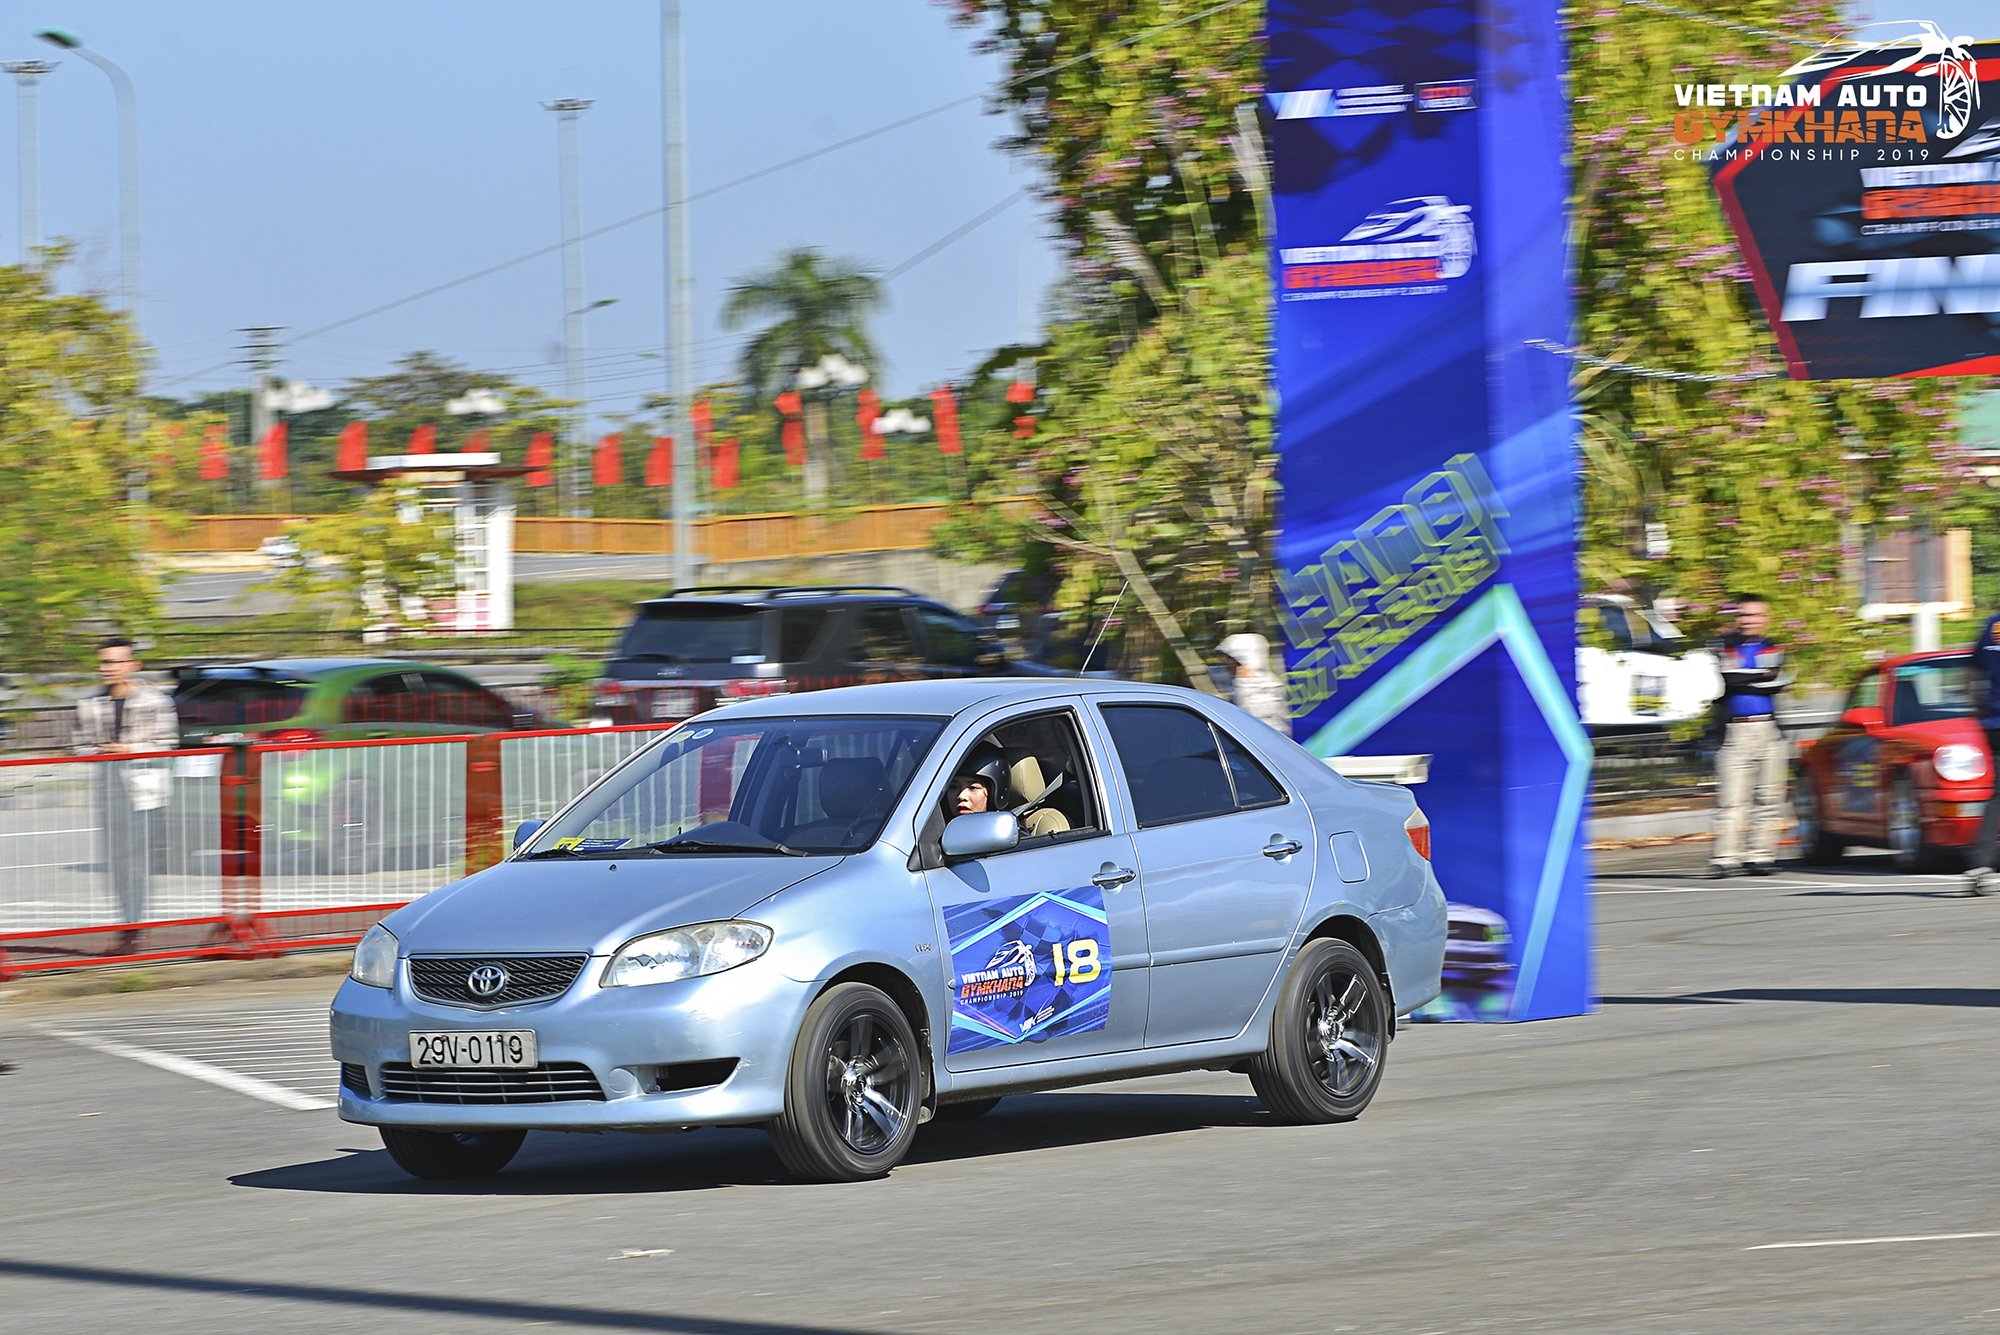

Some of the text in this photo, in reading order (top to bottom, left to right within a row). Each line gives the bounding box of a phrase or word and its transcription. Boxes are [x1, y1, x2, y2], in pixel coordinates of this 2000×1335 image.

[1001, 966, 1025, 977] AUTO
[1052, 938, 1101, 986] 18
[960, 990, 1024, 1006] CHAMPIONSHIP 2019
[961, 976, 1024, 998] GYMKHANA
[417, 1035, 523, 1065] 29V-0119
